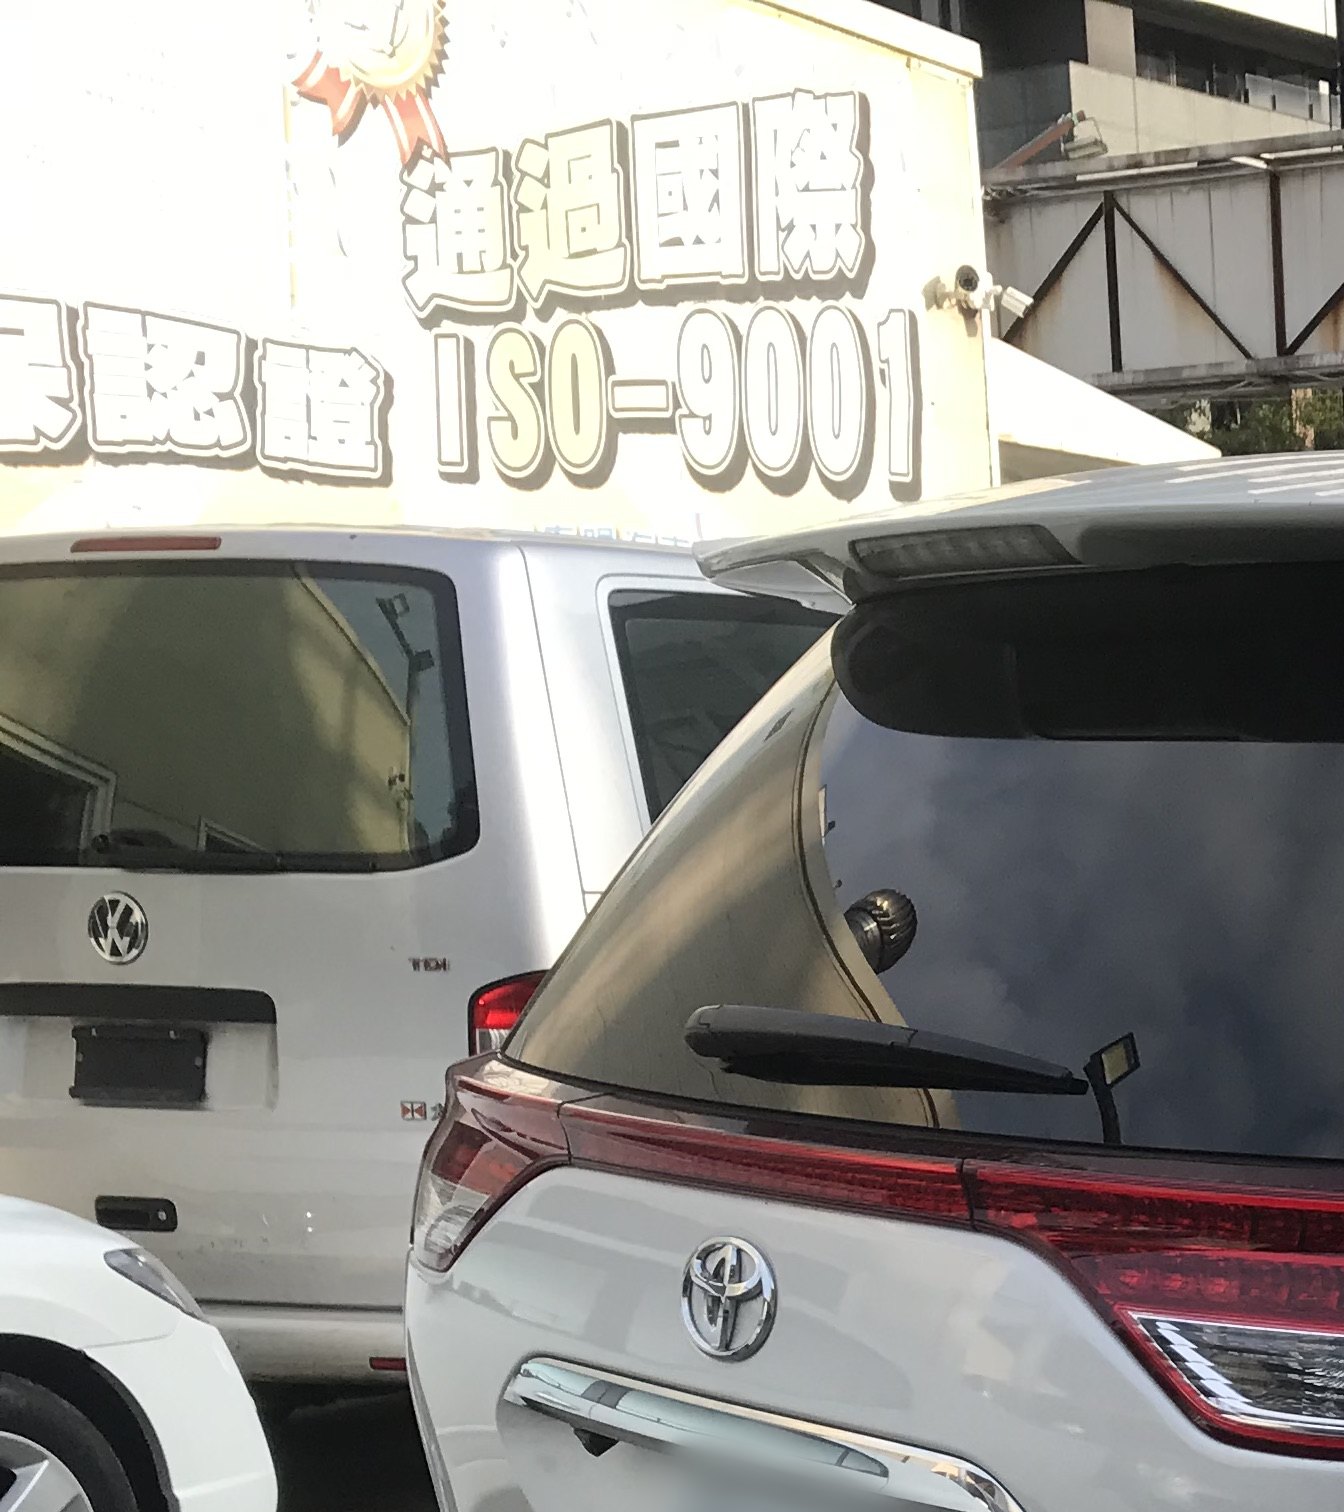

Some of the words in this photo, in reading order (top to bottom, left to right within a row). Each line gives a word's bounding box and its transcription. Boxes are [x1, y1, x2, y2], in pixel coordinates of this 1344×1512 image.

[402, 88, 864, 320] 通過國際
[432, 304, 918, 485] ISO-9001
